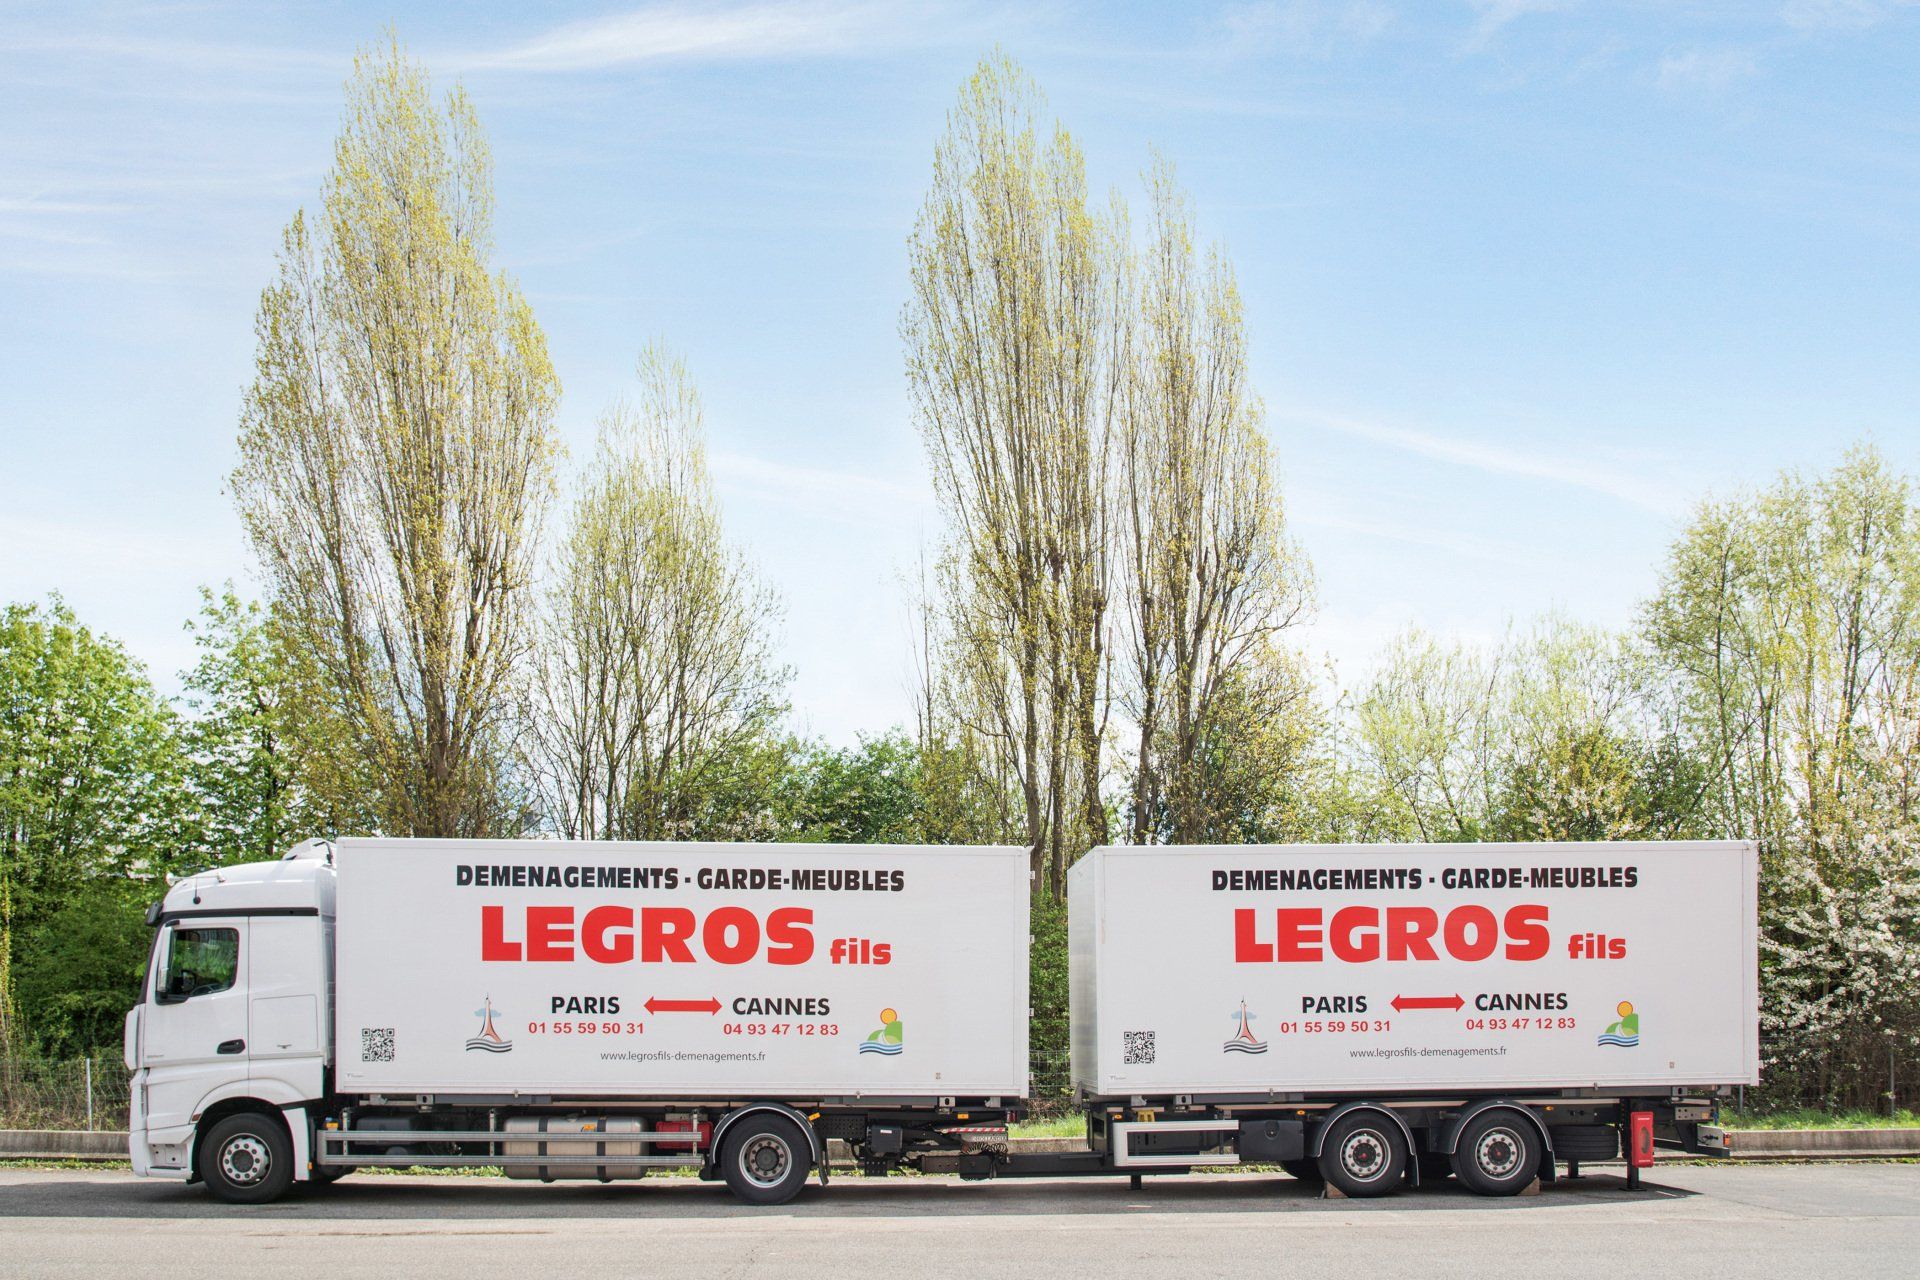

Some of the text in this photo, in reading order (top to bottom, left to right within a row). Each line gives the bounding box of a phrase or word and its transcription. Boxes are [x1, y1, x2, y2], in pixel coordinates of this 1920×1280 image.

[456, 864, 679, 890] DEMENAGEMENTS
[697, 867, 905, 892] GARDE-MEUBLES
[1212, 867, 1423, 891] DEMENAGEMENTS
[1441, 866, 1638, 890] GARDE-MEUBLES
[482, 905, 892, 966] LEGROS fils
[1234, 904, 1627, 964] LEGROS fils
[551, 996, 621, 1015] PARIS
[732, 996, 831, 1017] CANNES
[1302, 994, 1368, 1015] PARIS
[1474, 992, 1569, 1013] CANNES
[528, 1022, 645, 1034] 01 55 59 50 31
[723, 1023, 839, 1036] 04 93 47 12 83
[1280, 1020, 1392, 1034] 01 55 59 50 31
[1466, 1017, 1576, 1031] 04 93 47 12 83
[600, 1050, 767, 1063] www.legrosfils-demenagements.fr
[1349, 1045, 1508, 1060] www.legrosfils-demenagements.fr
